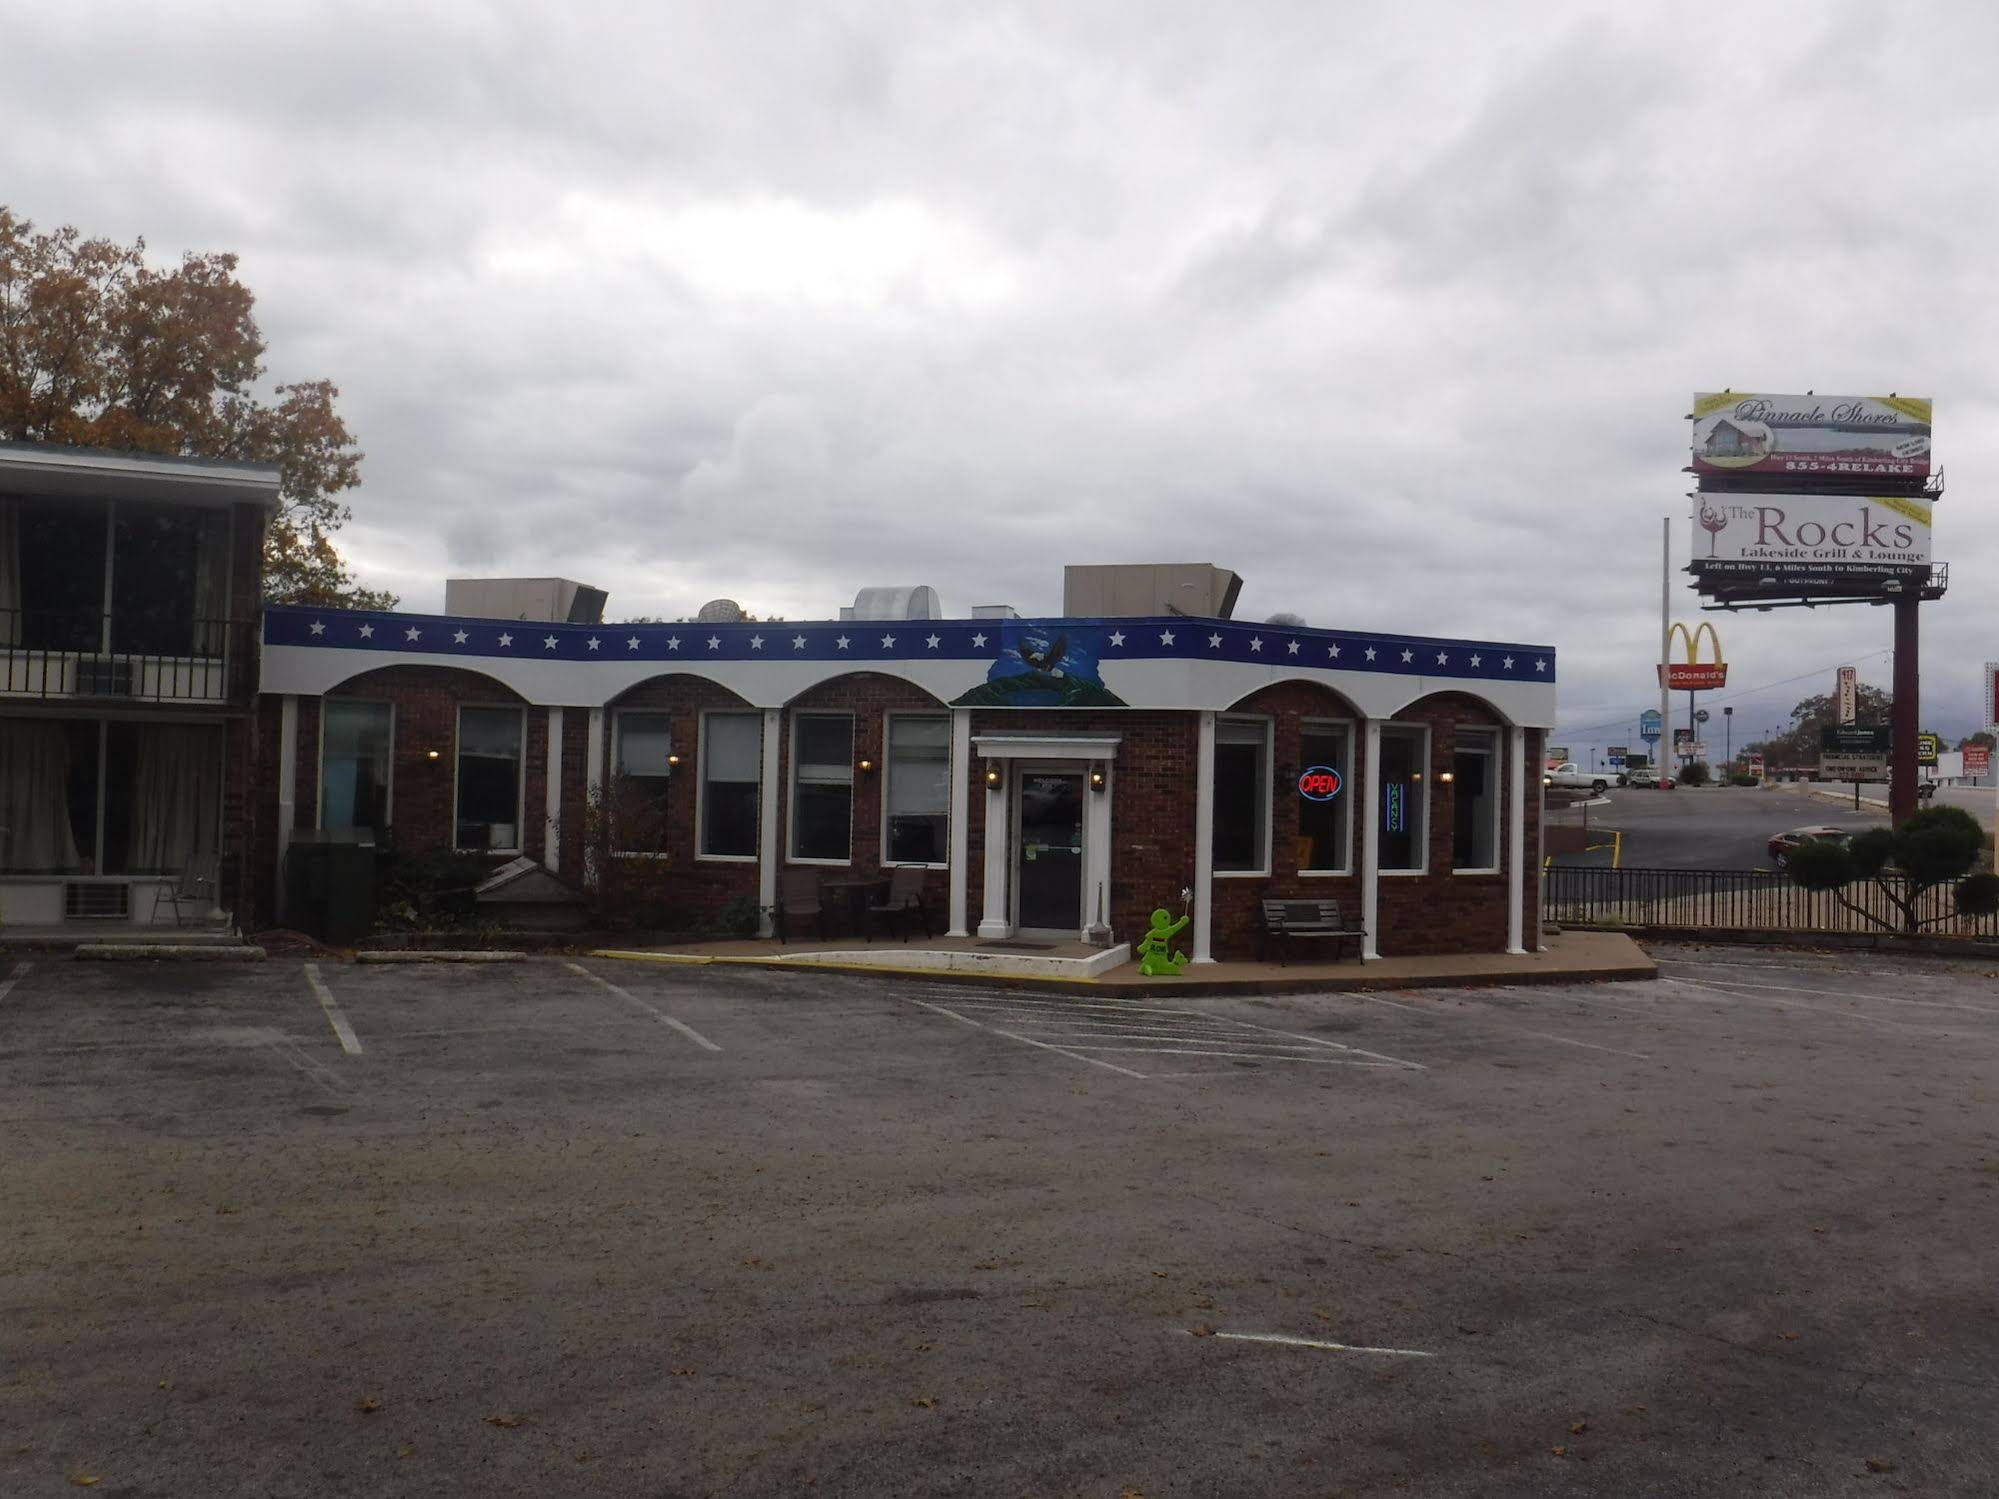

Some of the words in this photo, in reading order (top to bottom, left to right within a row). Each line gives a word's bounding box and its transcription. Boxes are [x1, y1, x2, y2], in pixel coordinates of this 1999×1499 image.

[1734, 398, 1825, 423] Pinnacle
[1832, 399, 1898, 425] Shores
[1785, 461, 1914, 473] 855-4RELAKE
[1728, 506, 1755, 520] The
[1753, 506, 1914, 549] Rocks
[1741, 547, 1808, 559] Lakeside
[1813, 548, 1846, 560] Grill
[1852, 549, 1864, 560] &
[1869, 549, 1925, 563] Lounge
[1705, 562, 1723, 571] Left
[1724, 563, 1736, 571] on
[1738, 562, 1757, 573] Hwy
[1783, 563, 1806, 572] Miles
[1808, 563, 1833, 572] South
[1834, 564, 1844, 572] to
[1846, 564, 1894, 575] Kimberling
[1896, 566, 1913, 576] City
[1665, 671, 1724, 680] cDonald's
[1642, 724, 1661, 735] Inn
[1301, 774, 1338, 793] OPEN
[1390, 783, 1399, 832] VACANCY
